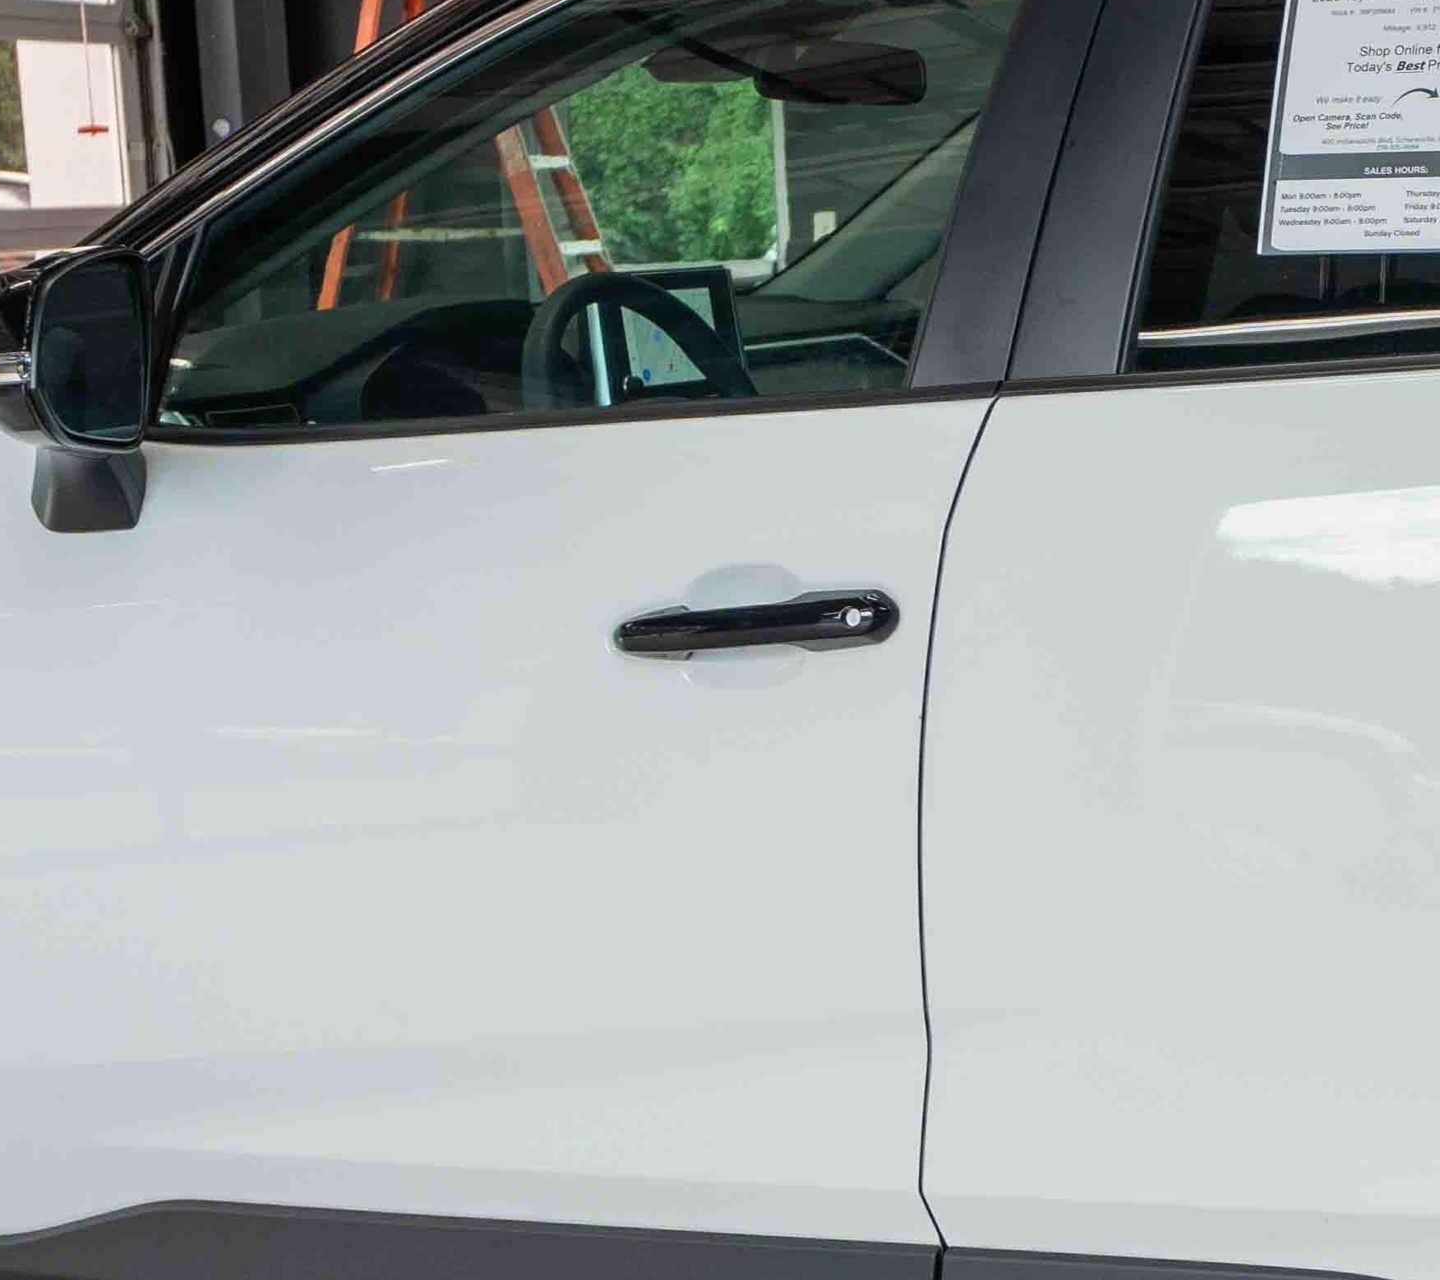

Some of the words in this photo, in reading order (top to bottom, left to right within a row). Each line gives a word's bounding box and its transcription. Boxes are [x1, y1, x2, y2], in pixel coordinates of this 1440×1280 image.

[1359, 46, 1391, 58] Shop
[1394, 44, 1433, 56] Online
[1347, 60, 1393, 73] Today's
[1395, 60, 1426, 71] Best
[1293, 114, 1316, 125] Open
[1355, 112, 1377, 121] Scan
[1325, 123, 1344, 131] See
[1346, 122, 1369, 130] Price!
[1364, 167, 1393, 176] SALES
[1281, 192, 1297, 200] Mon
[1406, 189, 1440, 199] Thursday
[1280, 205, 1311, 214] Tuesday
[1404, 203, 1428, 212] Friday
[1278, 218, 1322, 227] Wednesday
[1403, 215, 1439, 224] Saturday
[1363, 230, 1392, 239] Sunday
[1393, 229, 1420, 237] Closed
